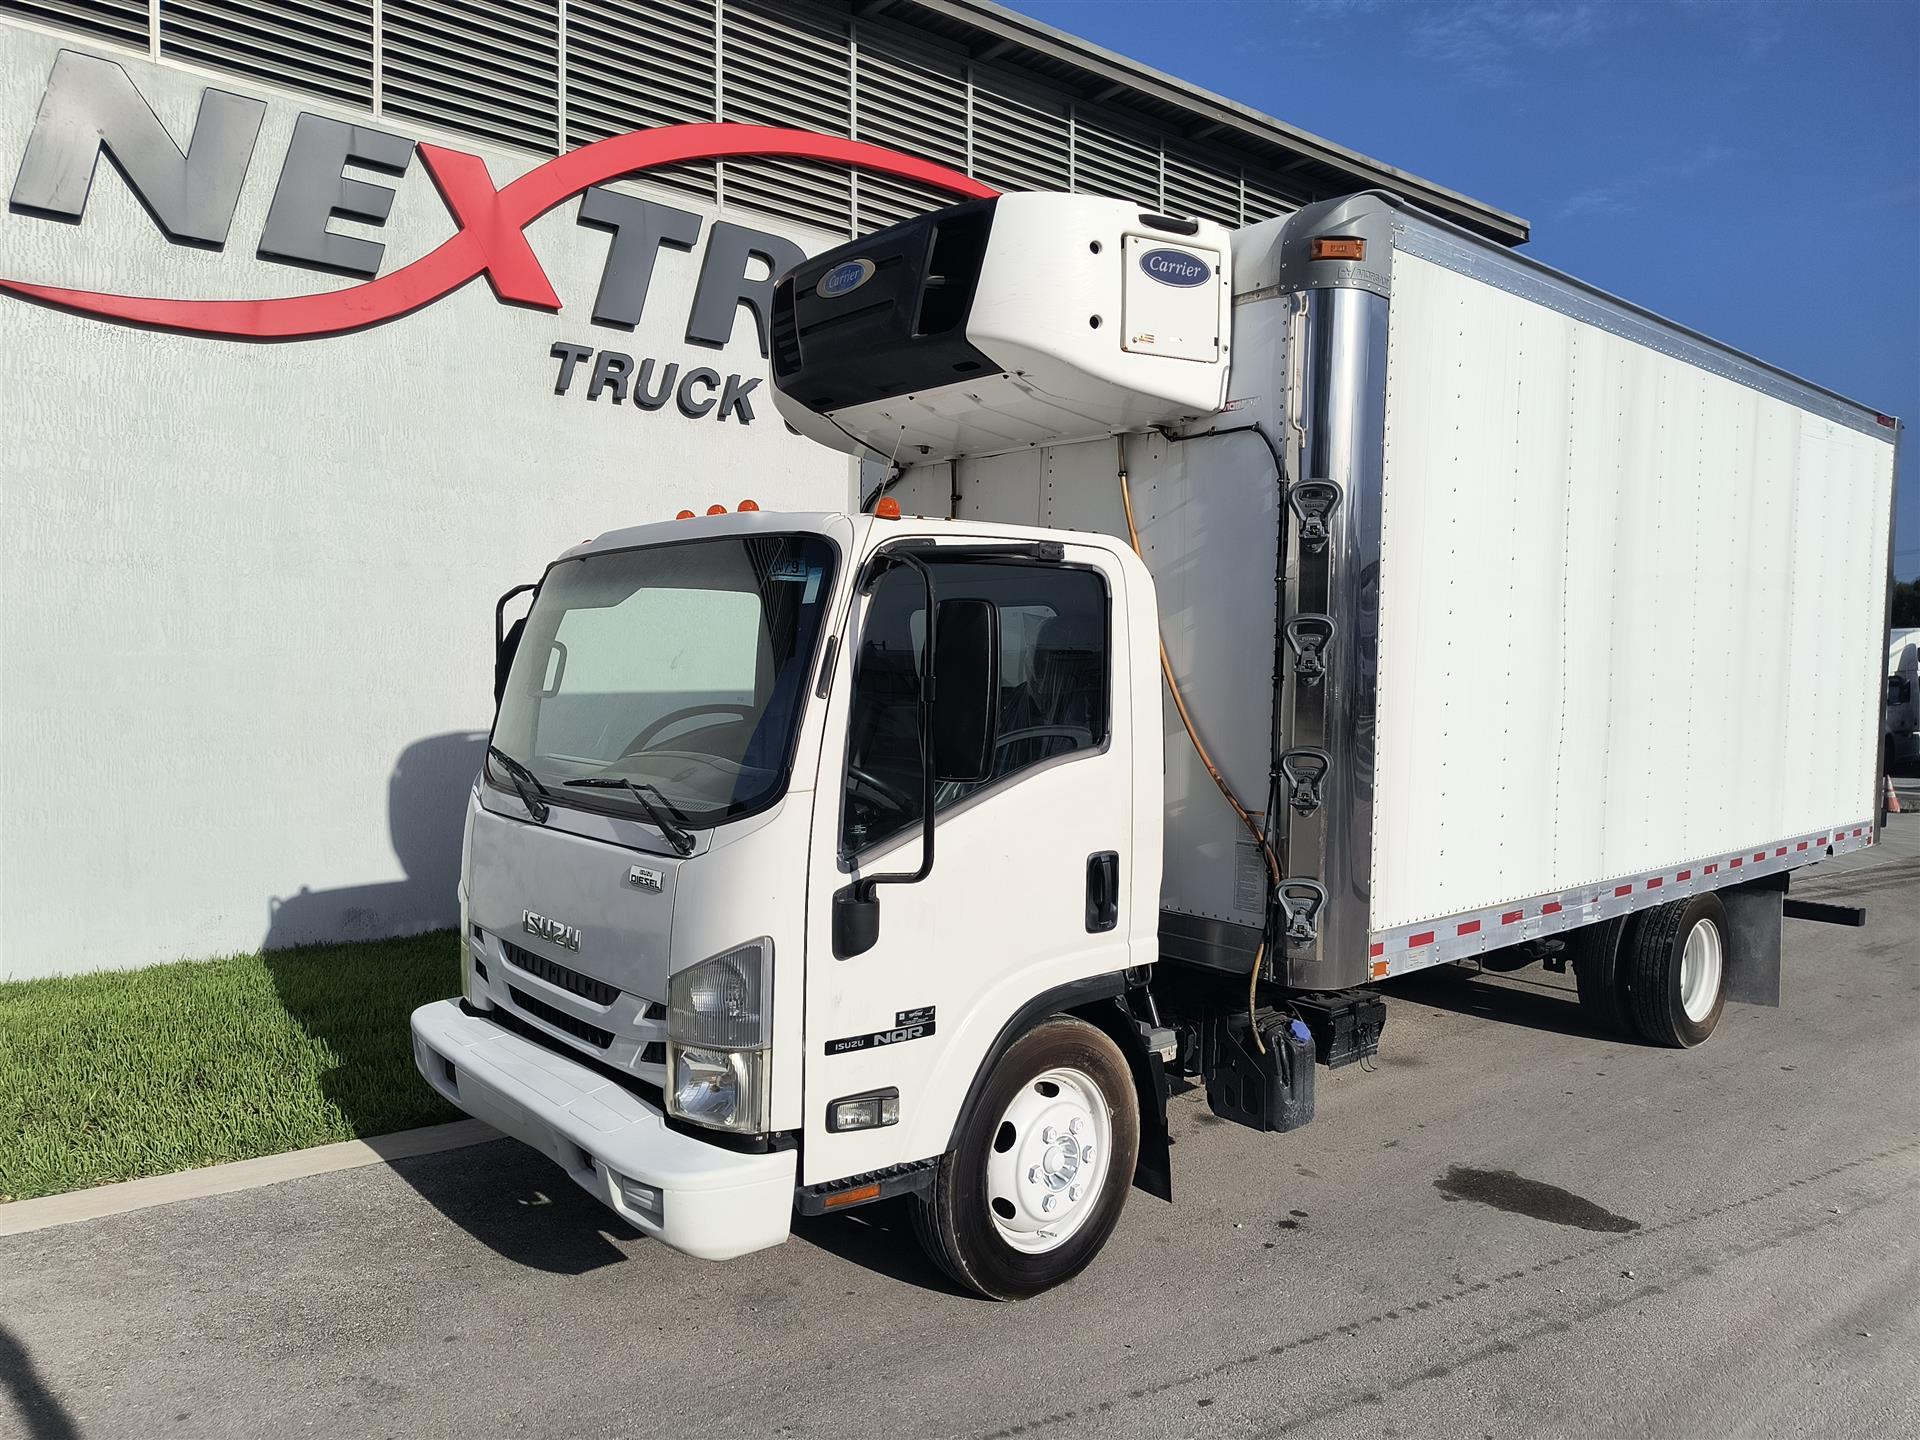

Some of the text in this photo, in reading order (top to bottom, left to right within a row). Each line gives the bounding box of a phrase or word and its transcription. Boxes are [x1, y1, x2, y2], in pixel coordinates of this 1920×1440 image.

[1149, 256, 1202, 278] Carrier
[828, 269, 860, 289] Carrier
[550, 341, 763, 425] TRUCK
[630, 874, 660, 889] DIESEL
[522, 909, 582, 954] ISUZU
[835, 1026, 924, 1051] ISUZU NQR
